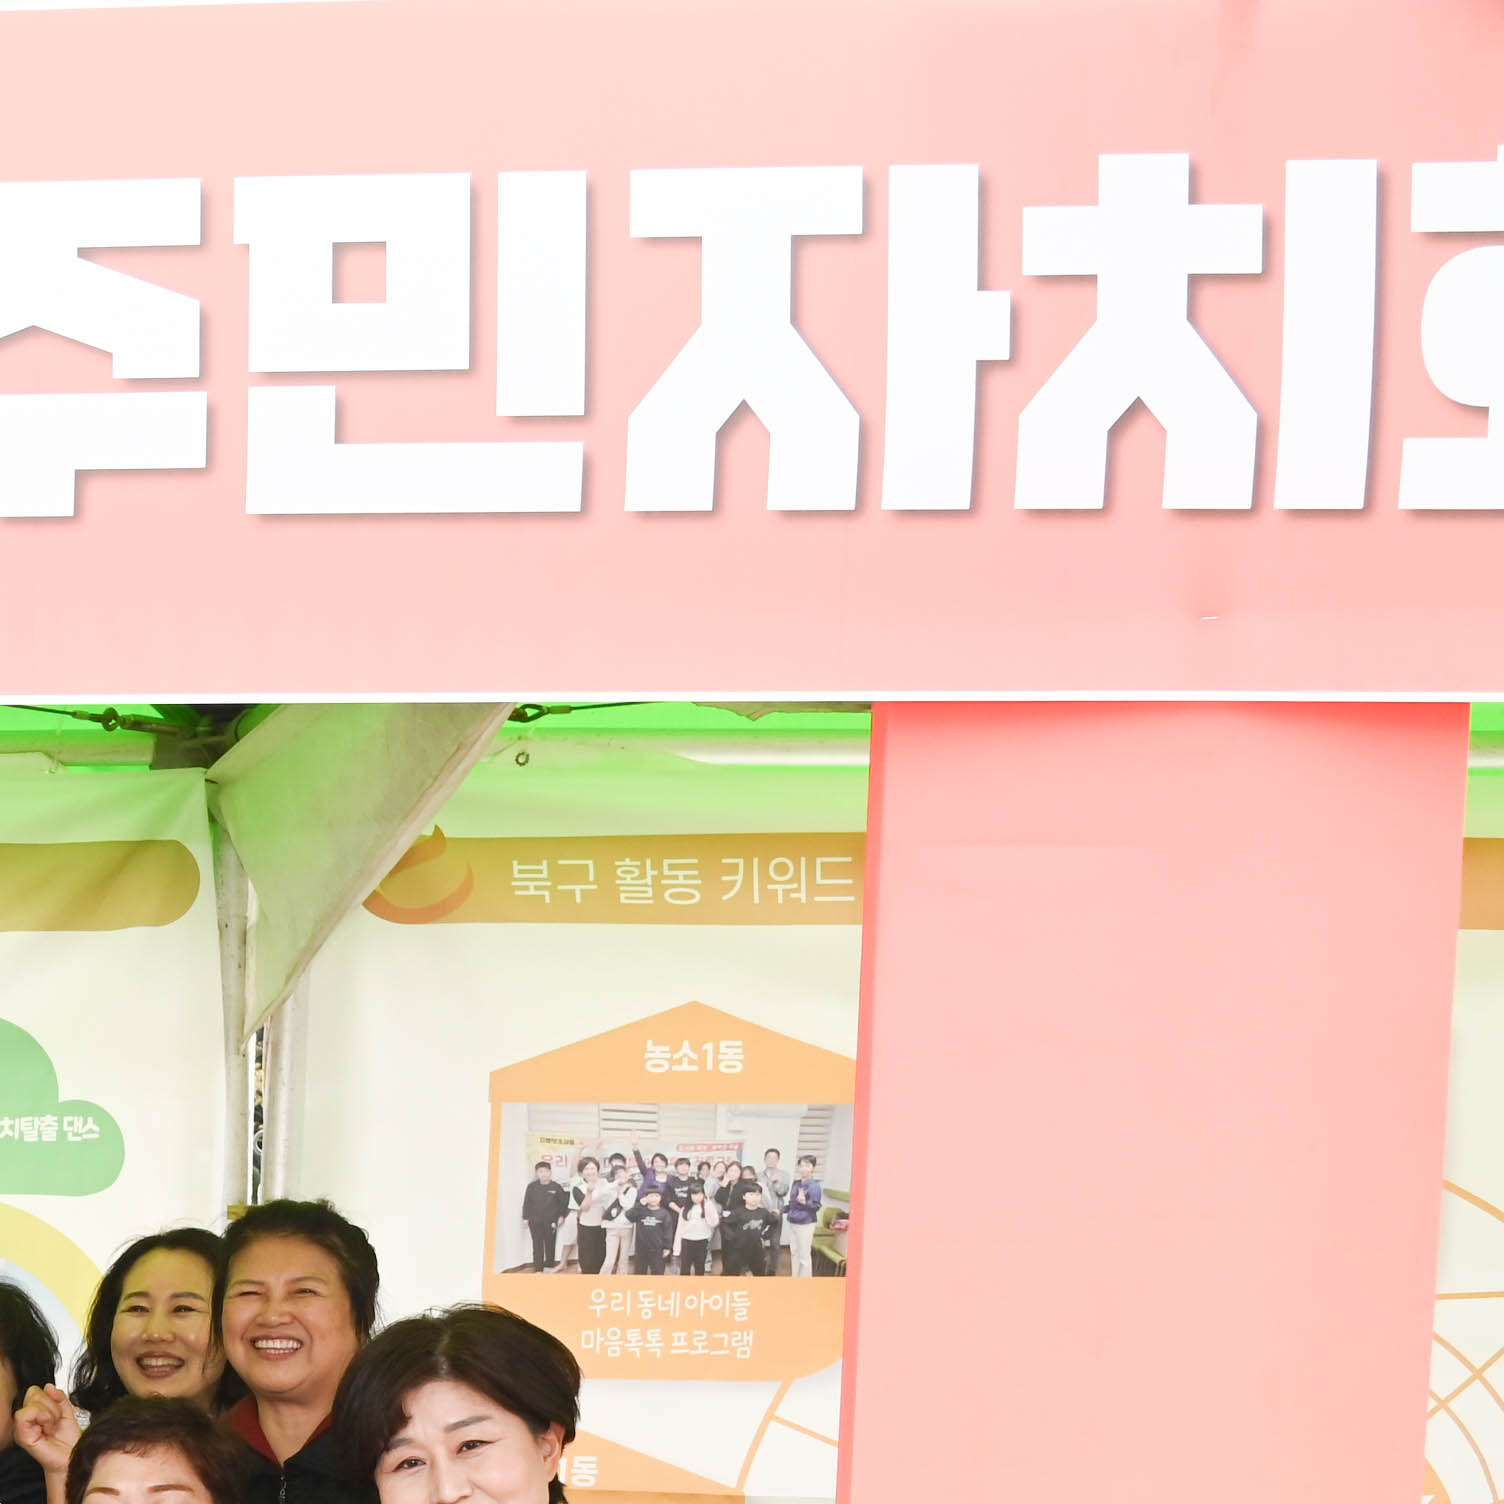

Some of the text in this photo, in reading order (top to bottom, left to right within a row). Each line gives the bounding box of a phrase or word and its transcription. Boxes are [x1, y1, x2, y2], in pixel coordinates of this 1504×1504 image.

[511, 856, 856, 905] 북구 활동 키워드
[644, 1039, 745, 1074] 농소1동
[62, 1113, 100, 1142] 댄스
[588, 1288, 752, 1322] 우리 동네 아이들
[581, 1328, 754, 1359] 마음톡톡 프로그램
